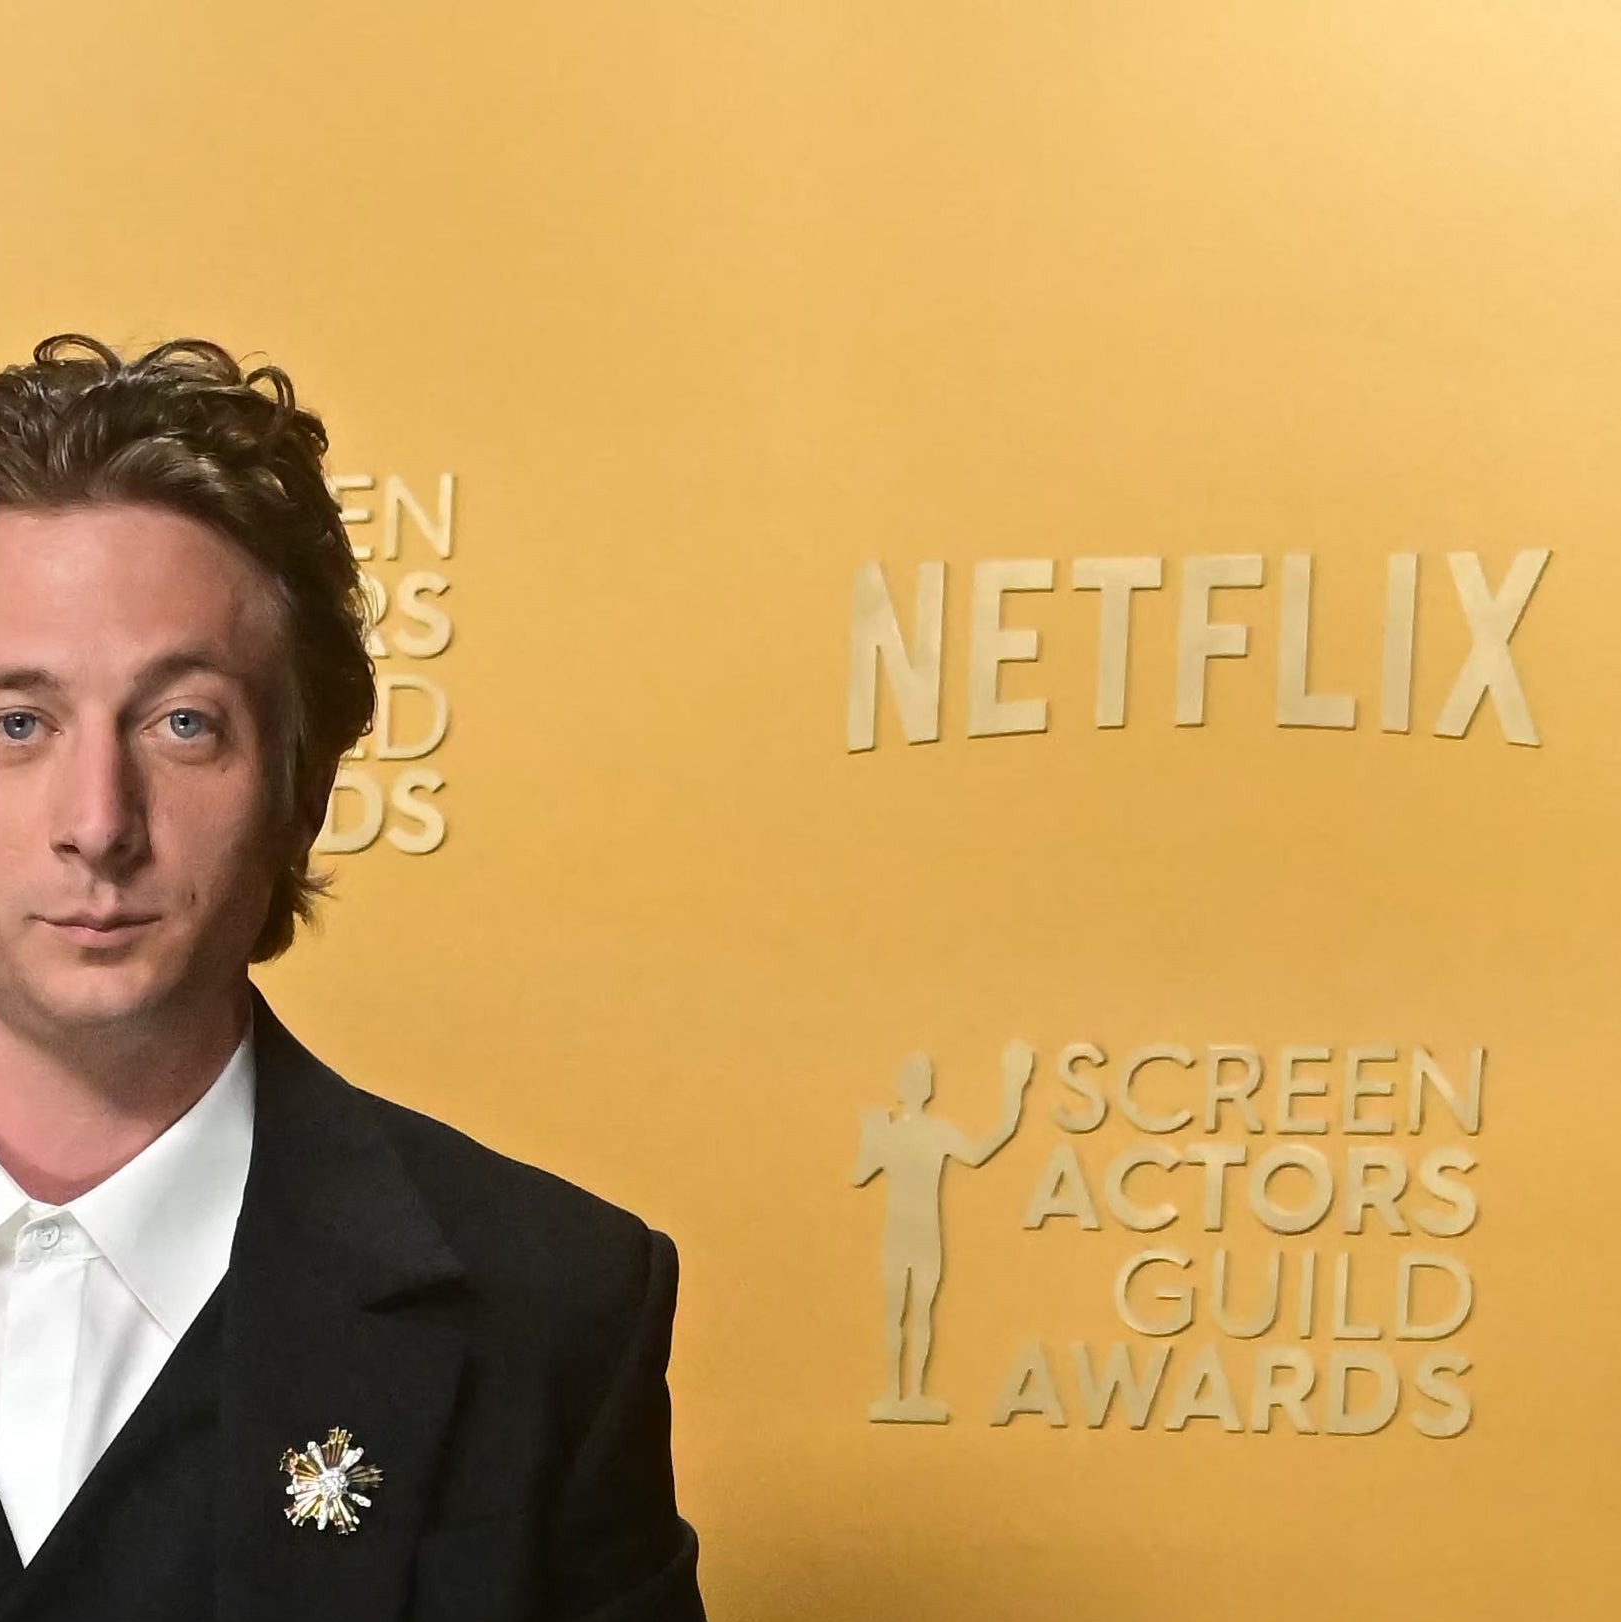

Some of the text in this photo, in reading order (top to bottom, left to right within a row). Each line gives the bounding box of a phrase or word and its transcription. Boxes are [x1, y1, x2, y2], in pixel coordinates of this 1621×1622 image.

[847, 548, 1553, 754] NETFLIX
[1052, 1043, 1487, 1136] SCREEN
[1022, 1143, 1479, 1237] ACTORS
[1115, 1248, 1473, 1341] GUILD
[989, 1341, 1473, 1439] AWARDS
